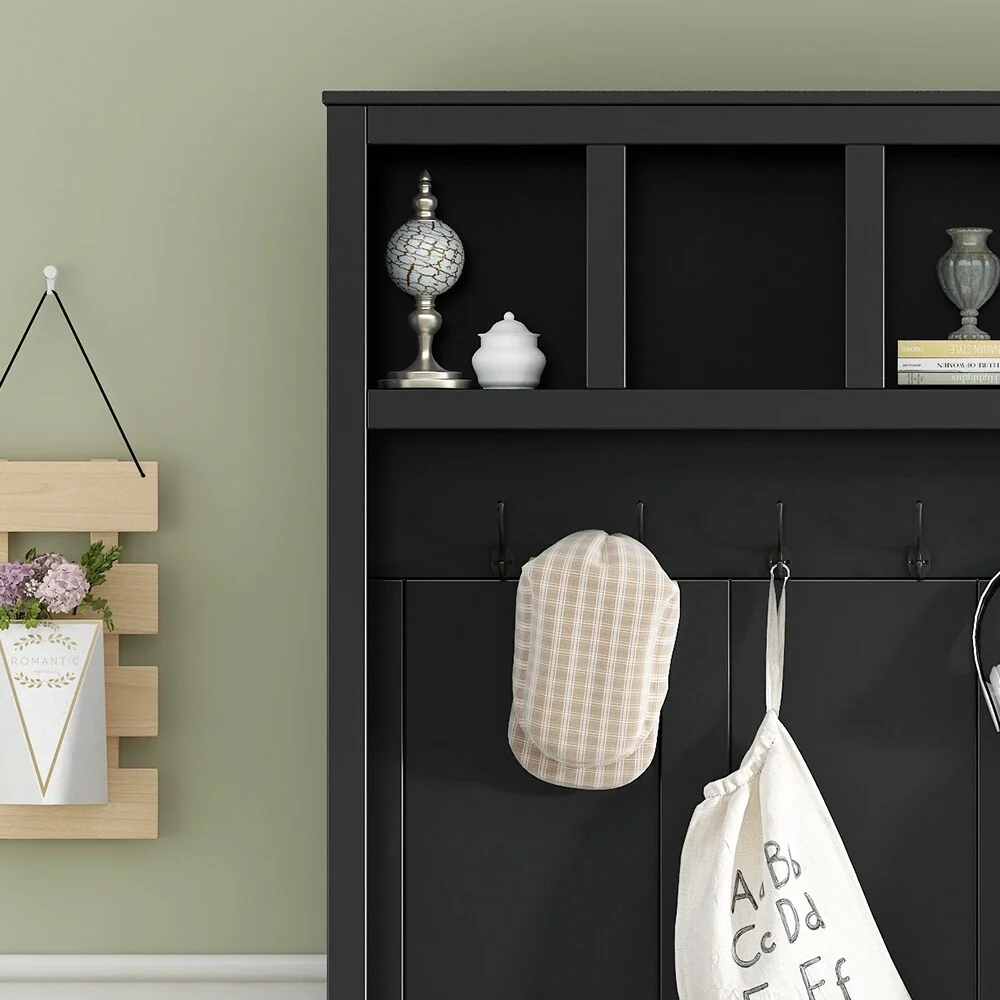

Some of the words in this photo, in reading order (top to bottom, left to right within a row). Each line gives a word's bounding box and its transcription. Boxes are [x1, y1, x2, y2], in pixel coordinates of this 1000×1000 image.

[949, 344, 972, 355] STYLE
[951, 373, 999, 385] Highlights
[11, 656, 79, 666] ROMANTIC
[731, 924, 777, 968] Cc
[775, 892, 826, 944] Dd
